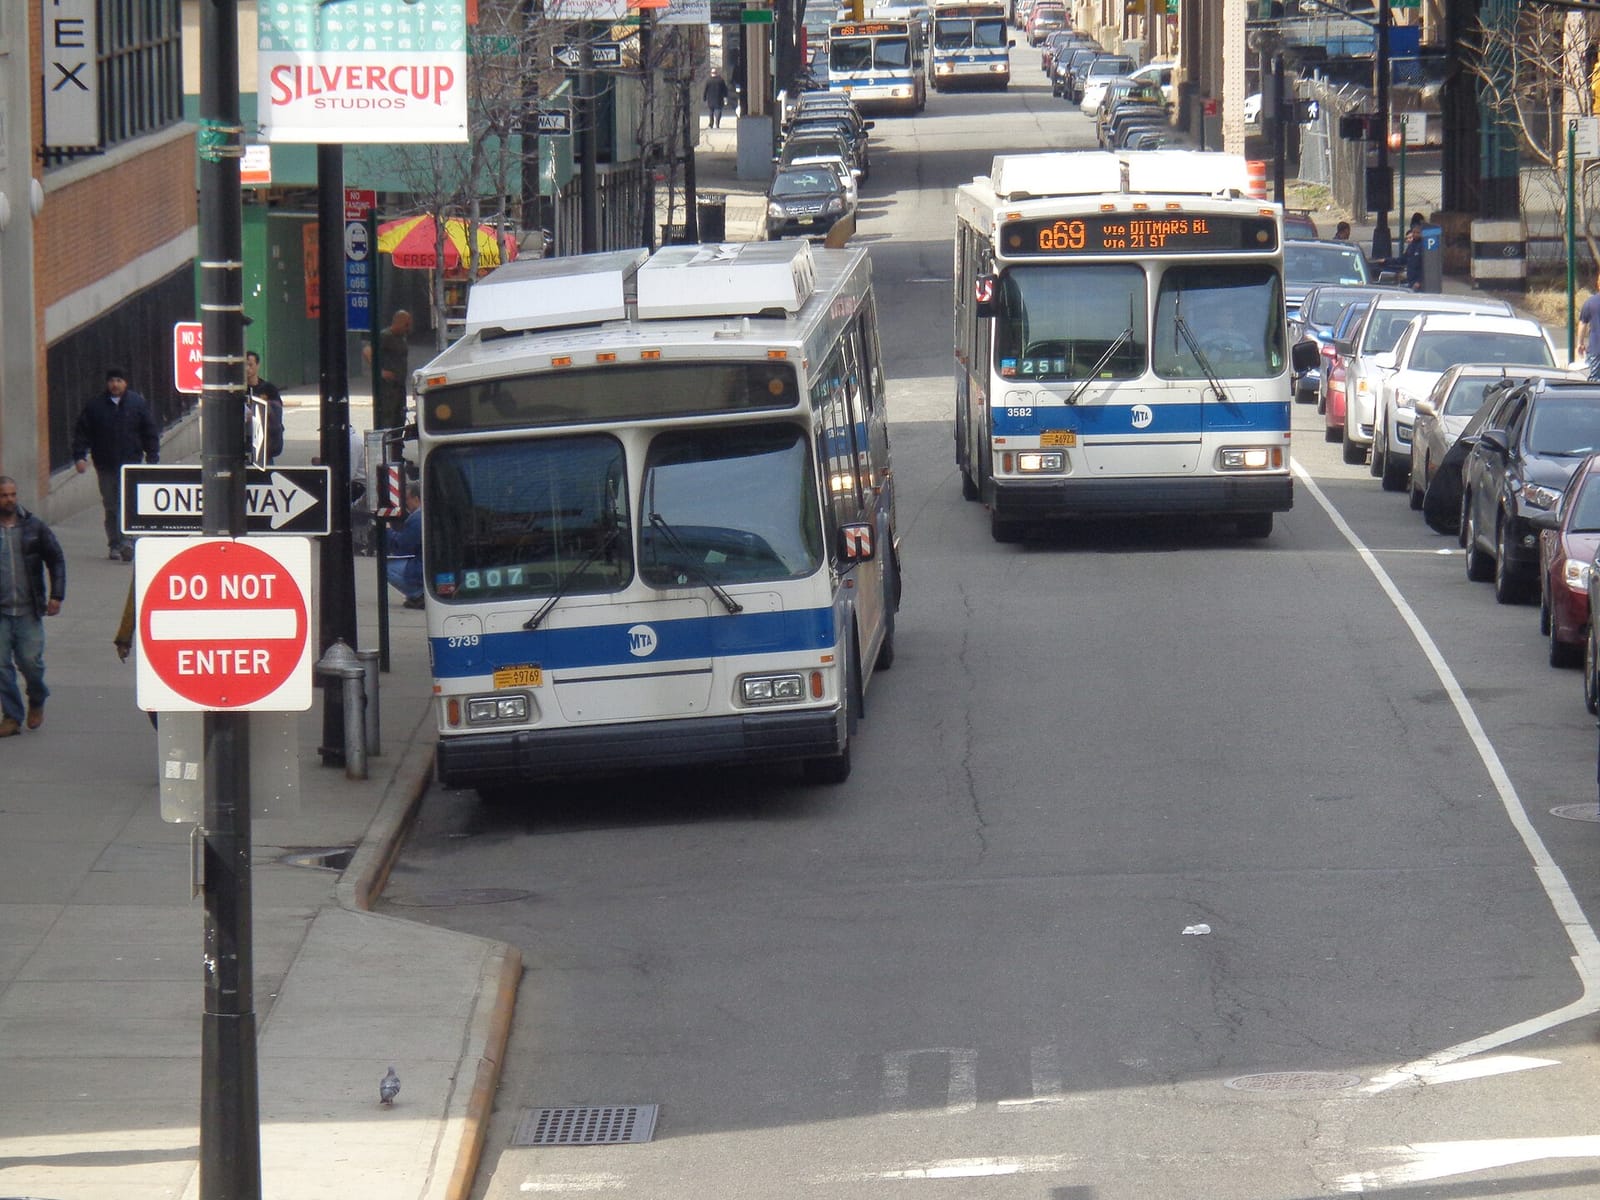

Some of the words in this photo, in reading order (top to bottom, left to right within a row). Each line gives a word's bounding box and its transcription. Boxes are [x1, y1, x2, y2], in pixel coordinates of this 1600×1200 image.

[52, 0, 89, 91] EX
[270, 64, 454, 106] SILVERCUP
[314, 97, 406, 109] STUDIOS
[350, 191, 360, 200] NO
[1039, 221, 1085, 249] Q69
[1129, 219, 1188, 234] DITMARS
[1192, 219, 1209, 234] BL
[1130, 235, 1144, 248] 21
[1149, 234, 1166, 247] ST
[1427, 238, 1435, 249] P
[403, 254, 436, 267] FRES
[181, 331, 194, 345] NO
[1007, 407, 1032, 417] 3582
[1131, 409, 1149, 423] MTA
[465, 568, 522, 588] 807
[169, 575, 208, 600] DO
[220, 574, 277, 600] NOT
[448, 635, 479, 648] 3739
[628, 632, 653, 651] MTA
[178, 650, 271, 675] ENTER
